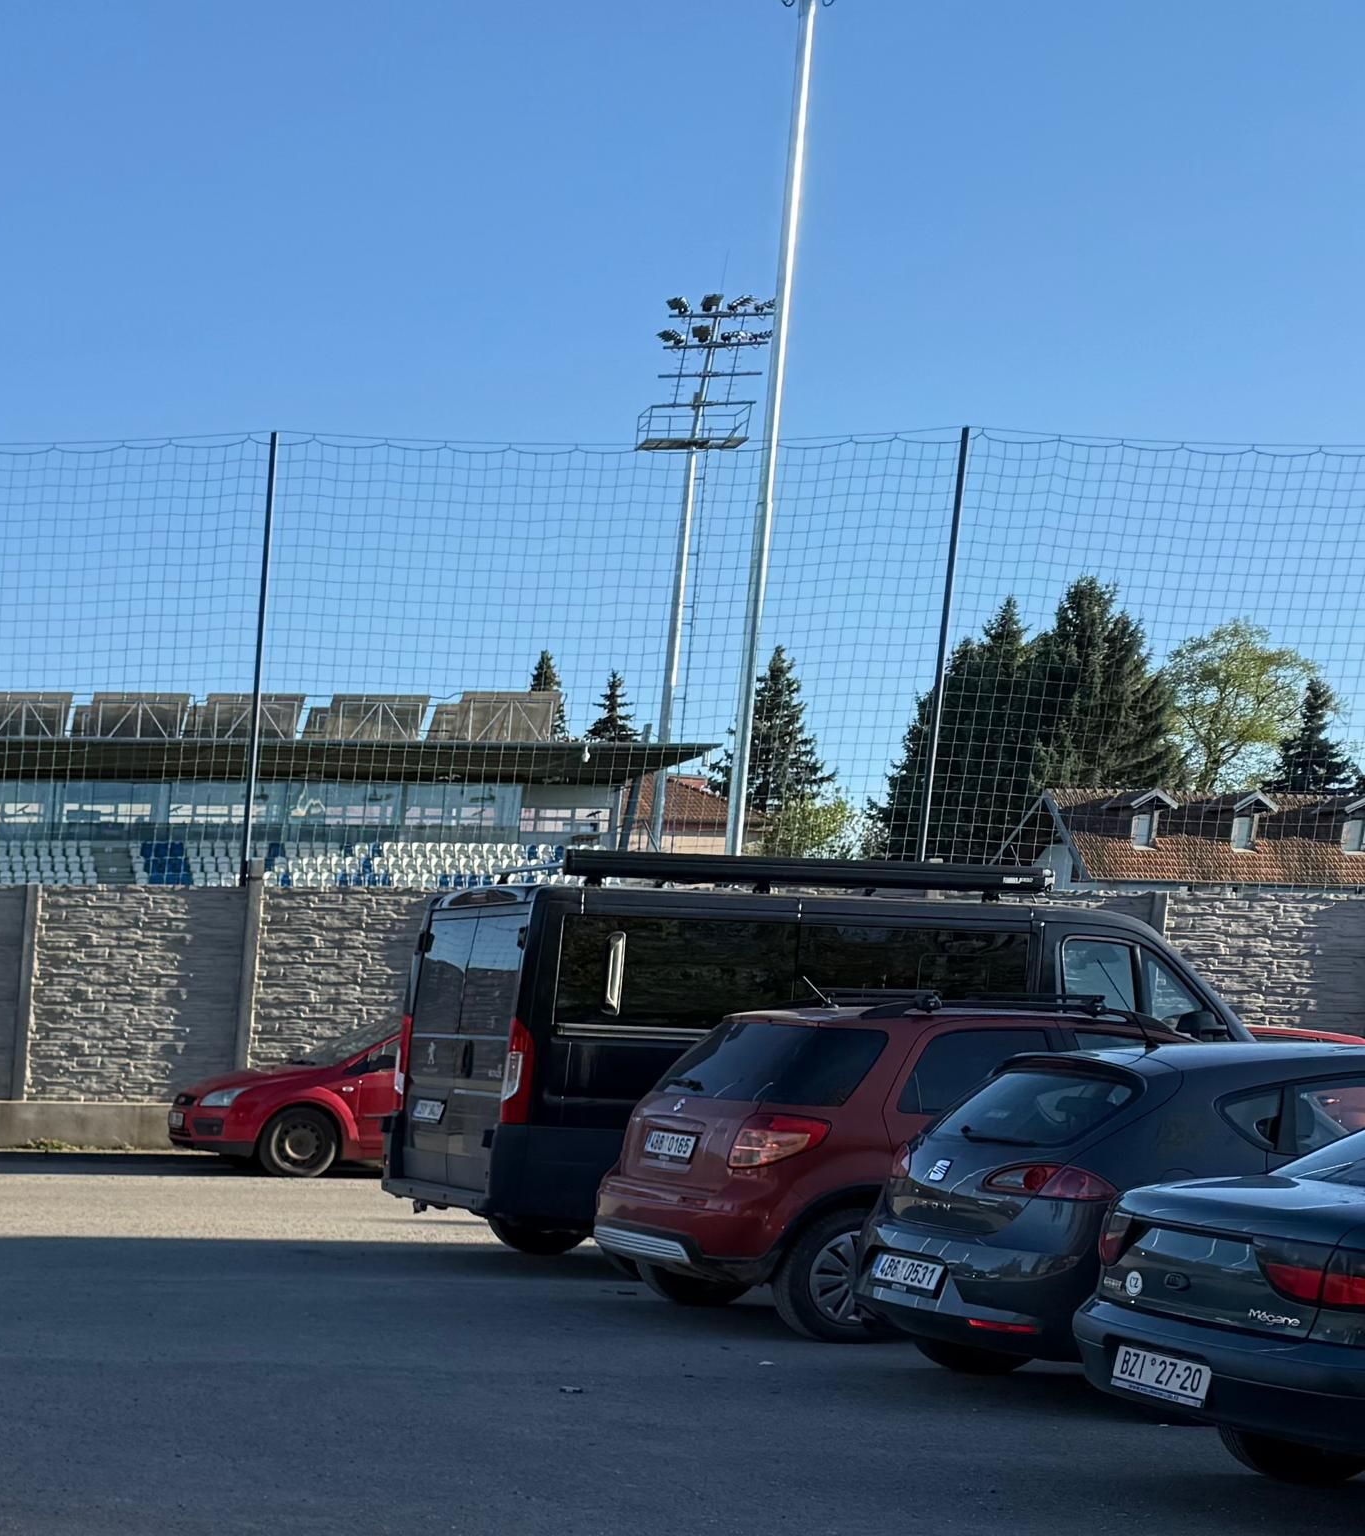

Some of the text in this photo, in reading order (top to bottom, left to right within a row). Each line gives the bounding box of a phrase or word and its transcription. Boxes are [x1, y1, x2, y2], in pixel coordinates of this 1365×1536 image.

[667, 1136, 691, 1154] 0165
[903, 1262, 937, 1286] 0531
[1155, 1359, 1202, 1393] 27-20
